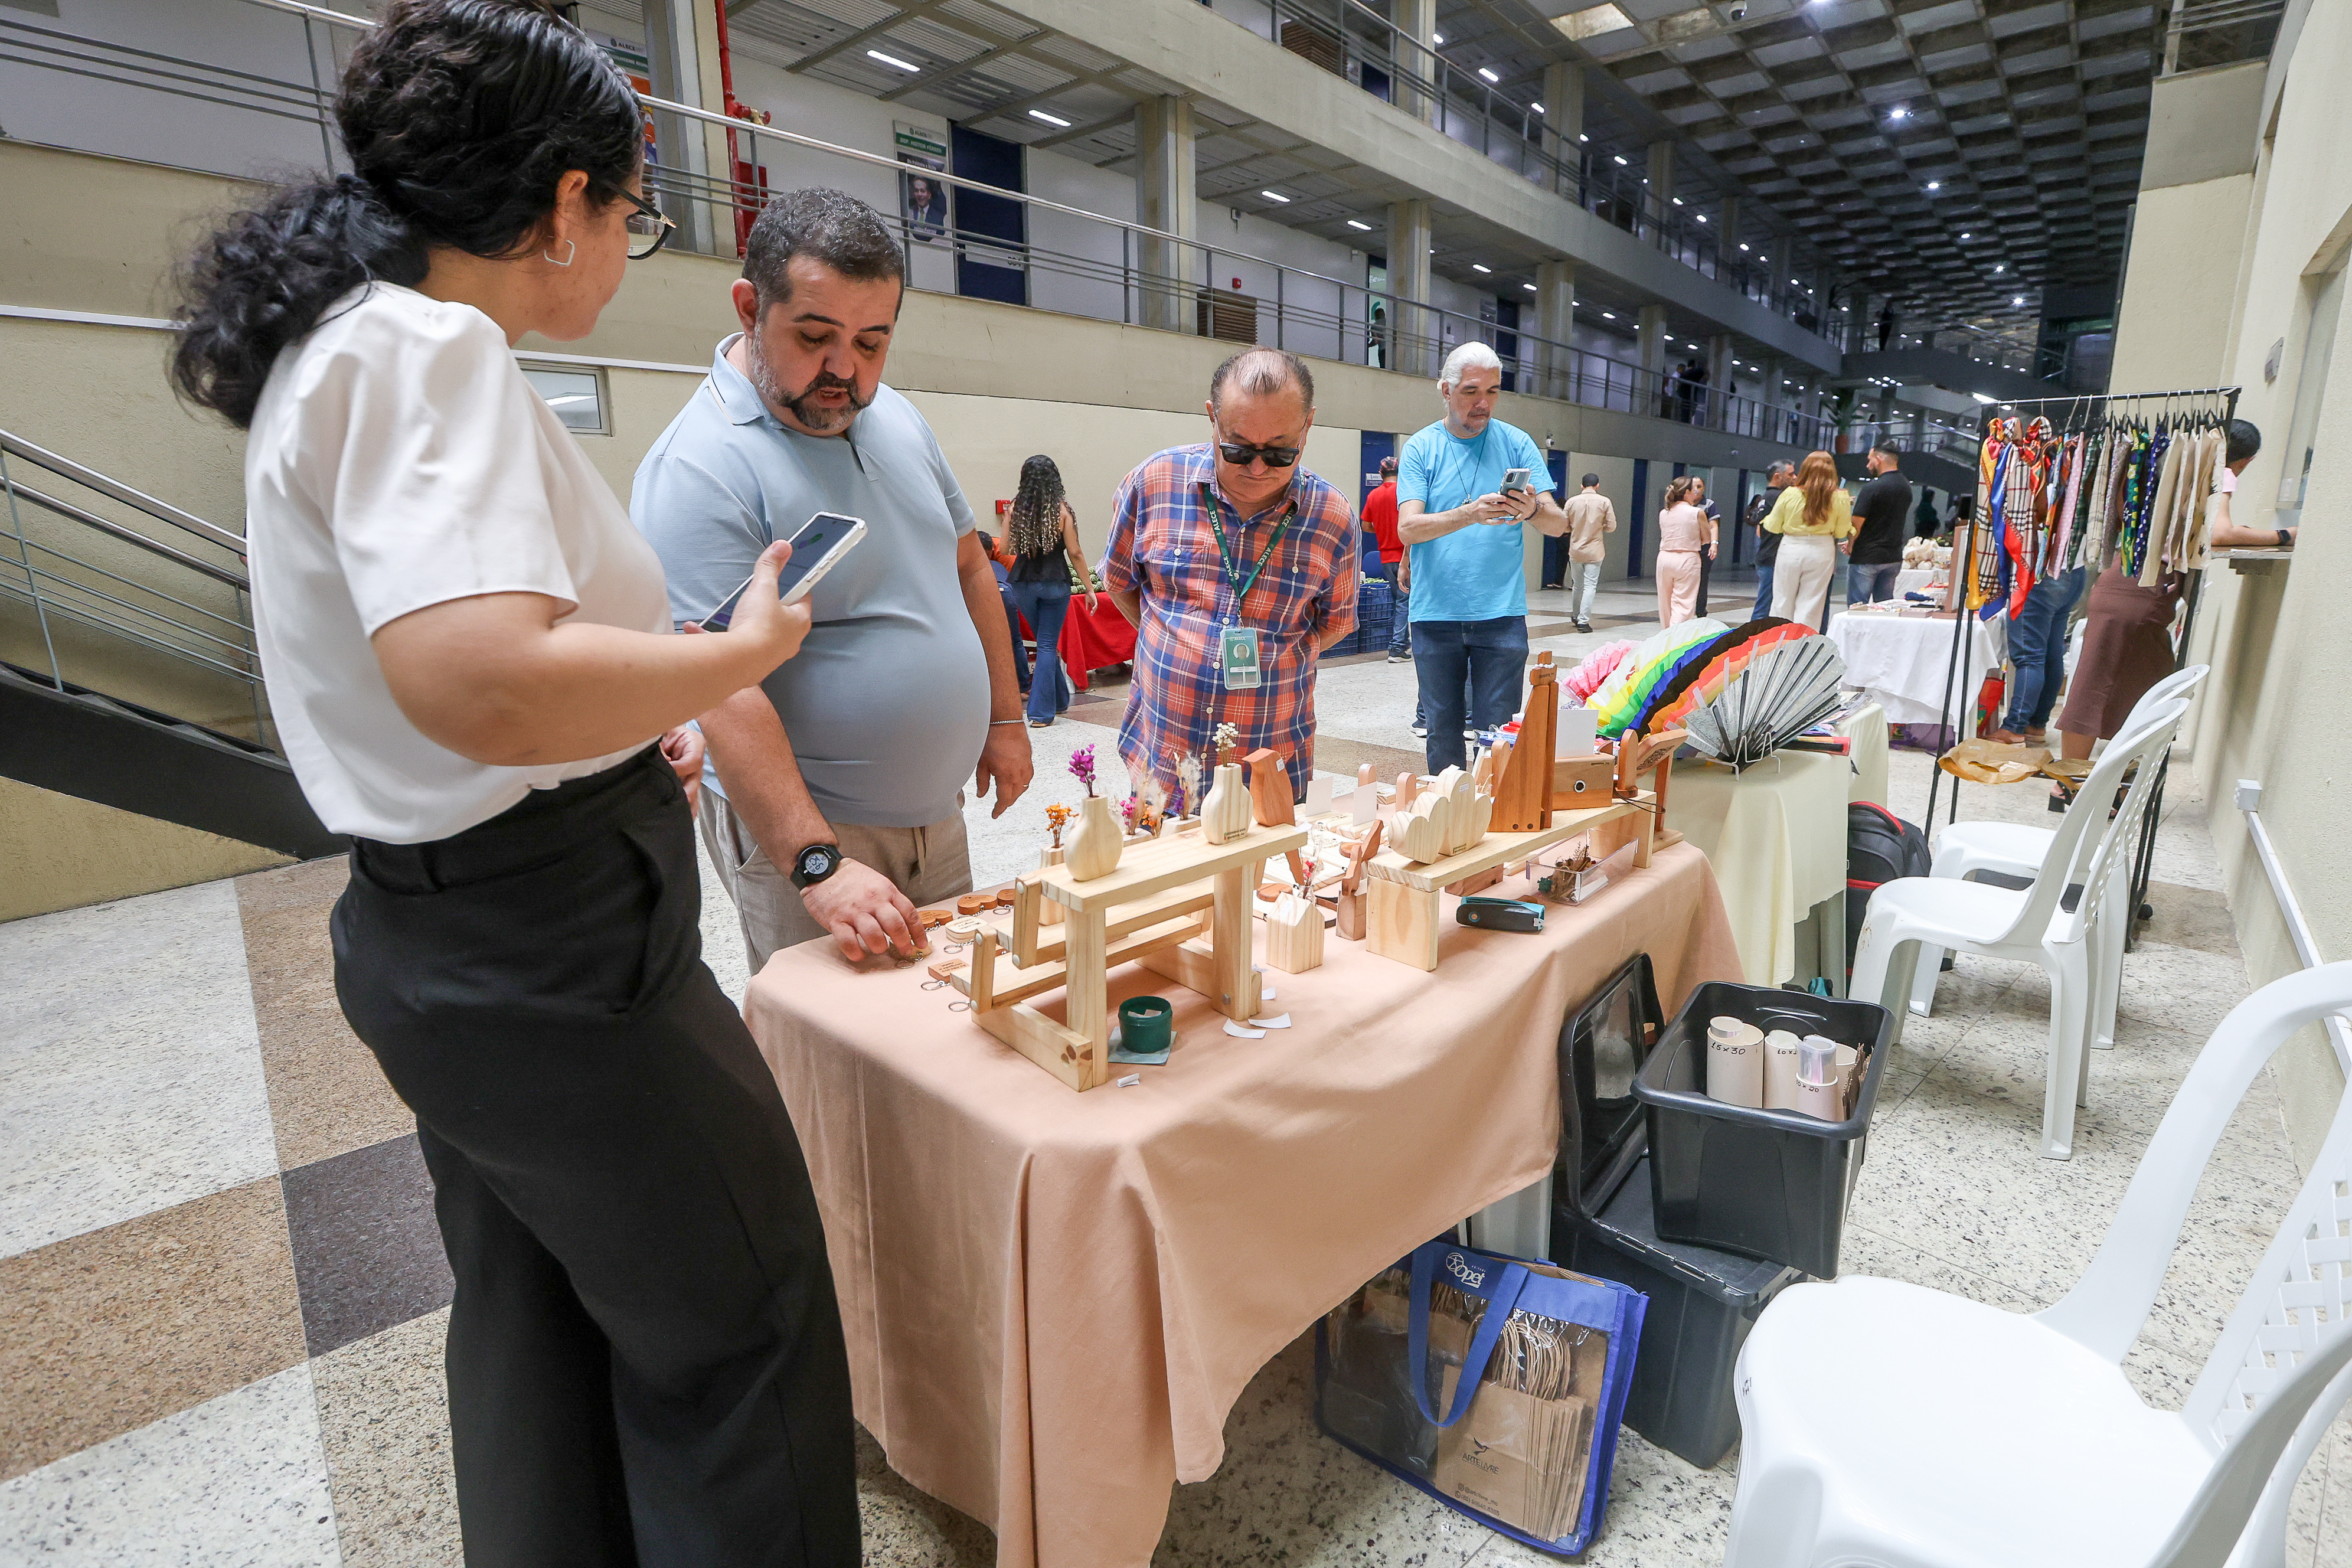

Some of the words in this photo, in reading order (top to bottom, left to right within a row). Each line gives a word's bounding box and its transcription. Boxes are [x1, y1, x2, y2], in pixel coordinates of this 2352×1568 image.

[1210, 509, 1220, 531] ALECE
[1223, 556, 1233, 577] ALECE
[1257, 547, 1271, 566] ALECE
